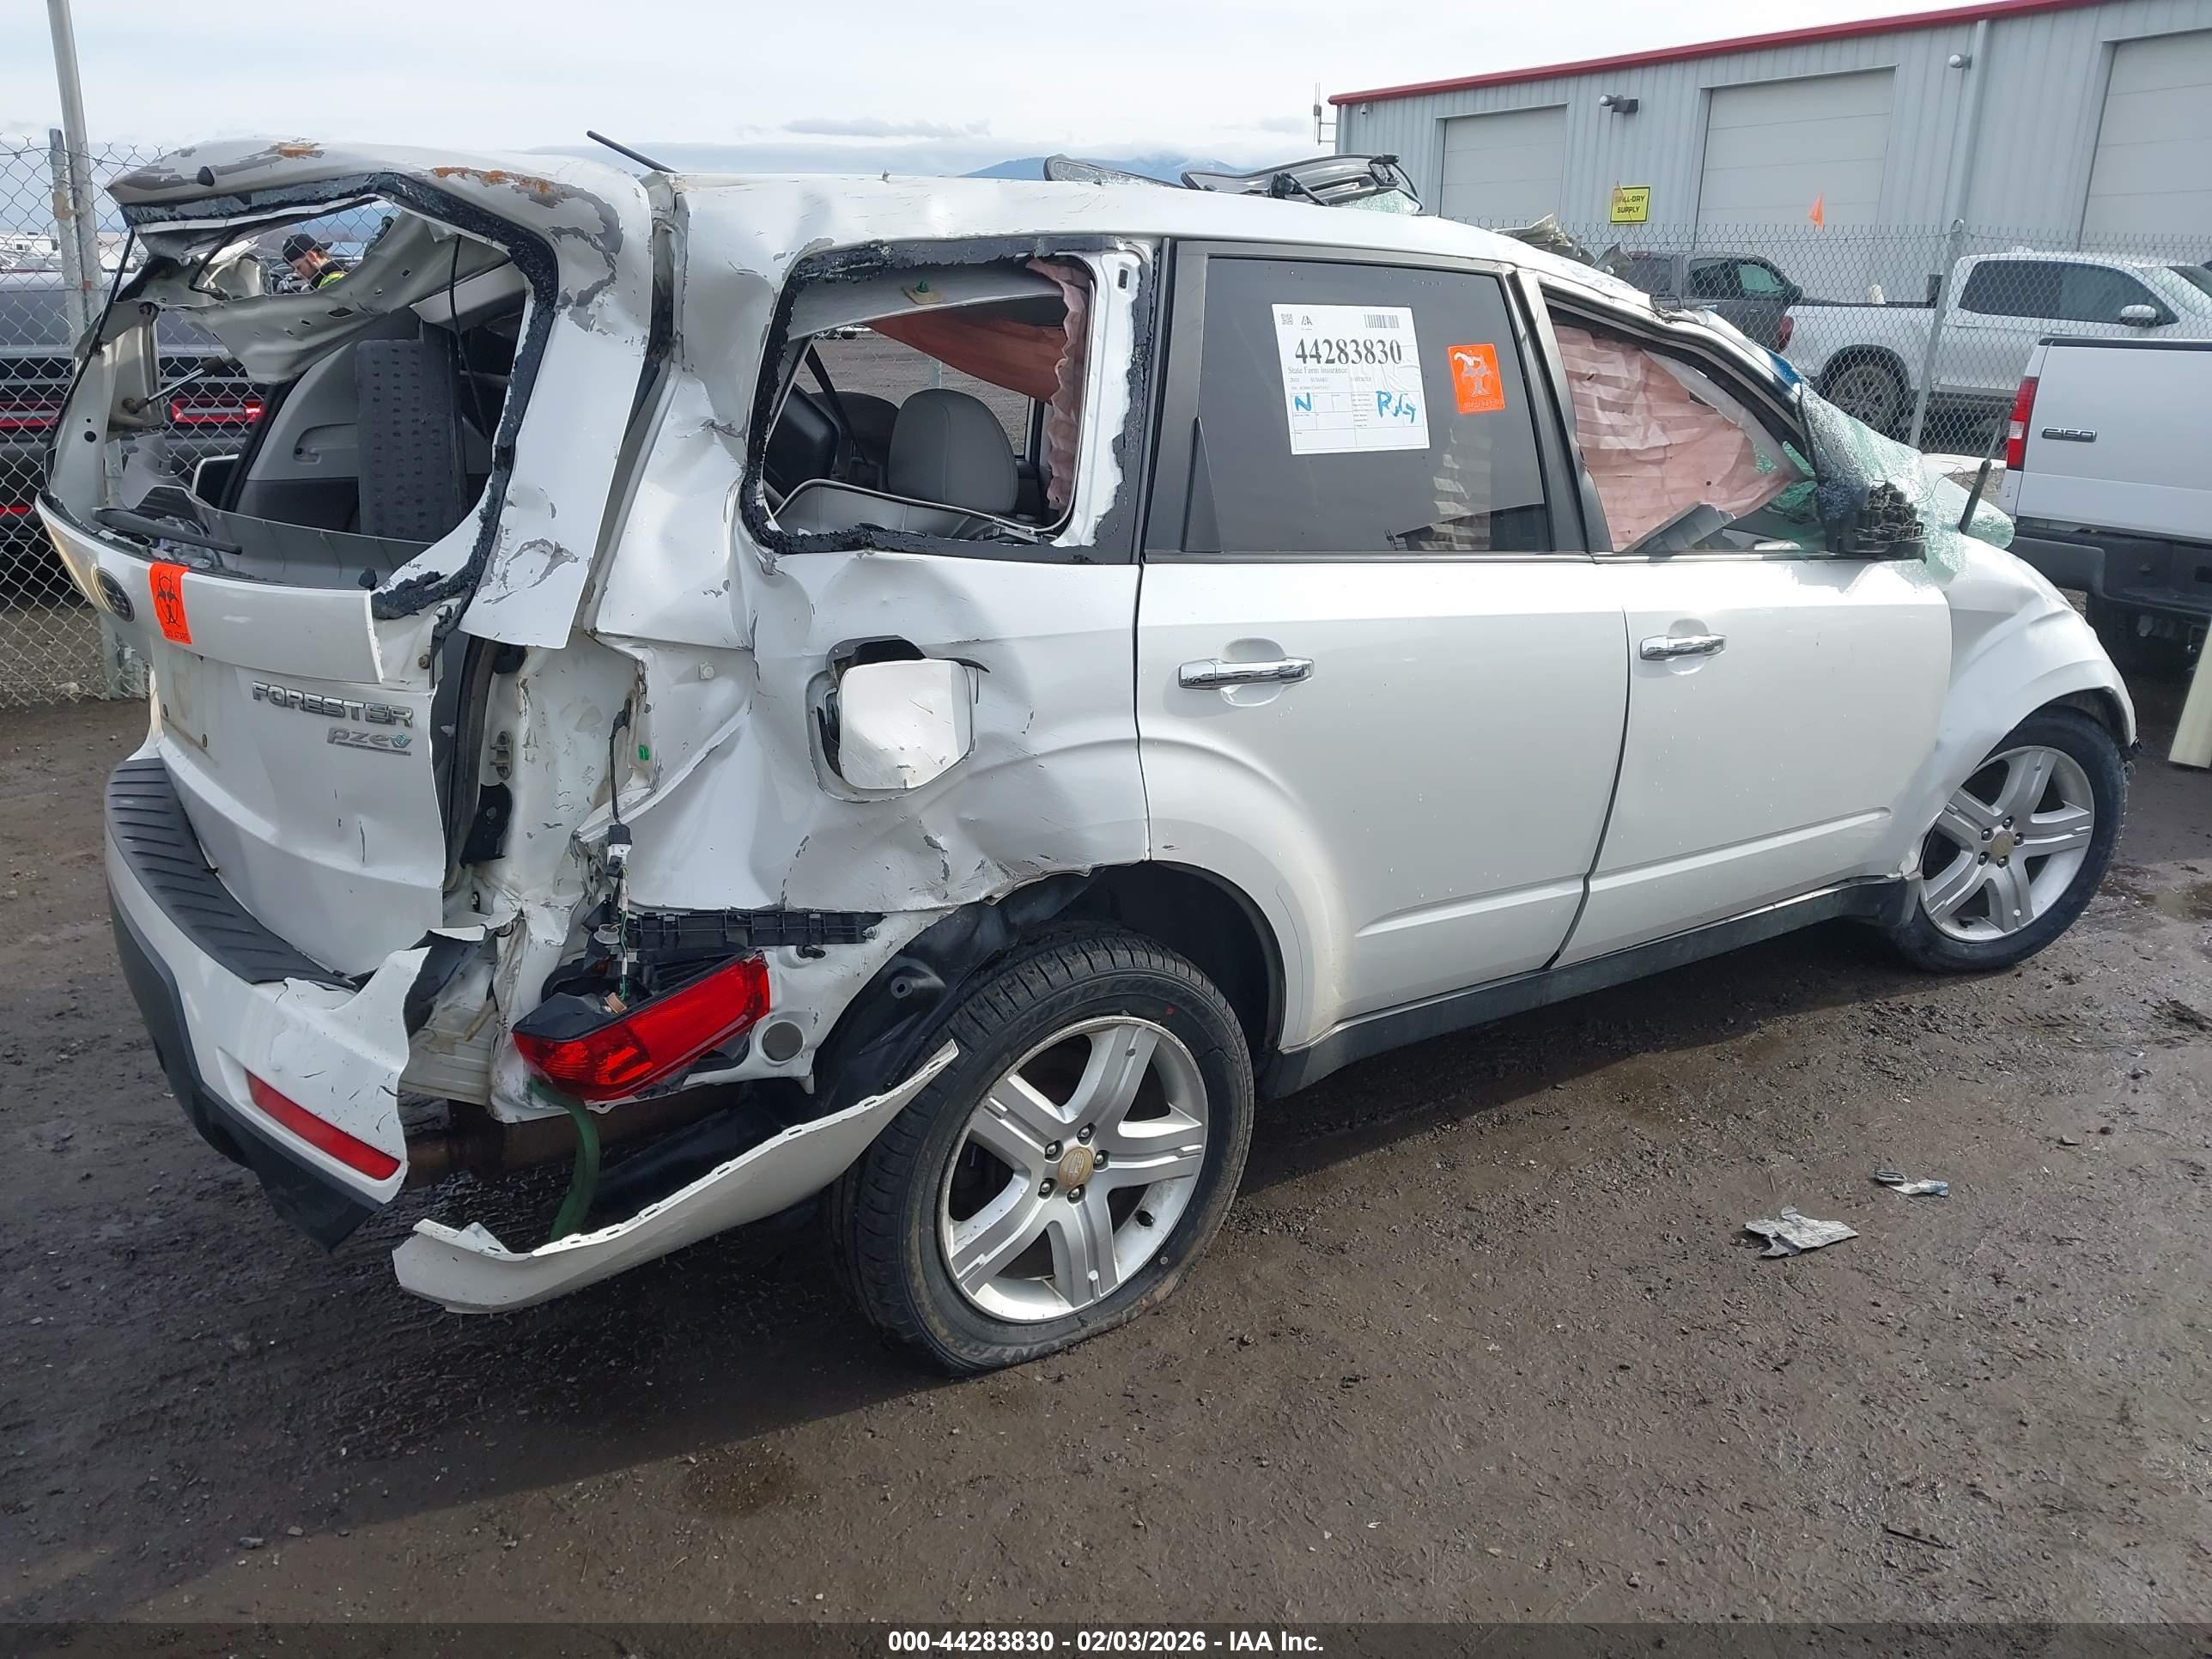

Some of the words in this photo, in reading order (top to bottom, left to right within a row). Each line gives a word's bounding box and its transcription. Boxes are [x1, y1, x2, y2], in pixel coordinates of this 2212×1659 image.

[1617, 205, 1640, 214] SUPPLY
[1295, 337, 1402, 365] 44283830
[1288, 366, 1303, 374] State
[1304, 366, 1320, 374] Farm
[1321, 366, 1347, 374] Insurance
[1295, 392, 1312, 412] N
[252, 681, 414, 728] FORESTER
